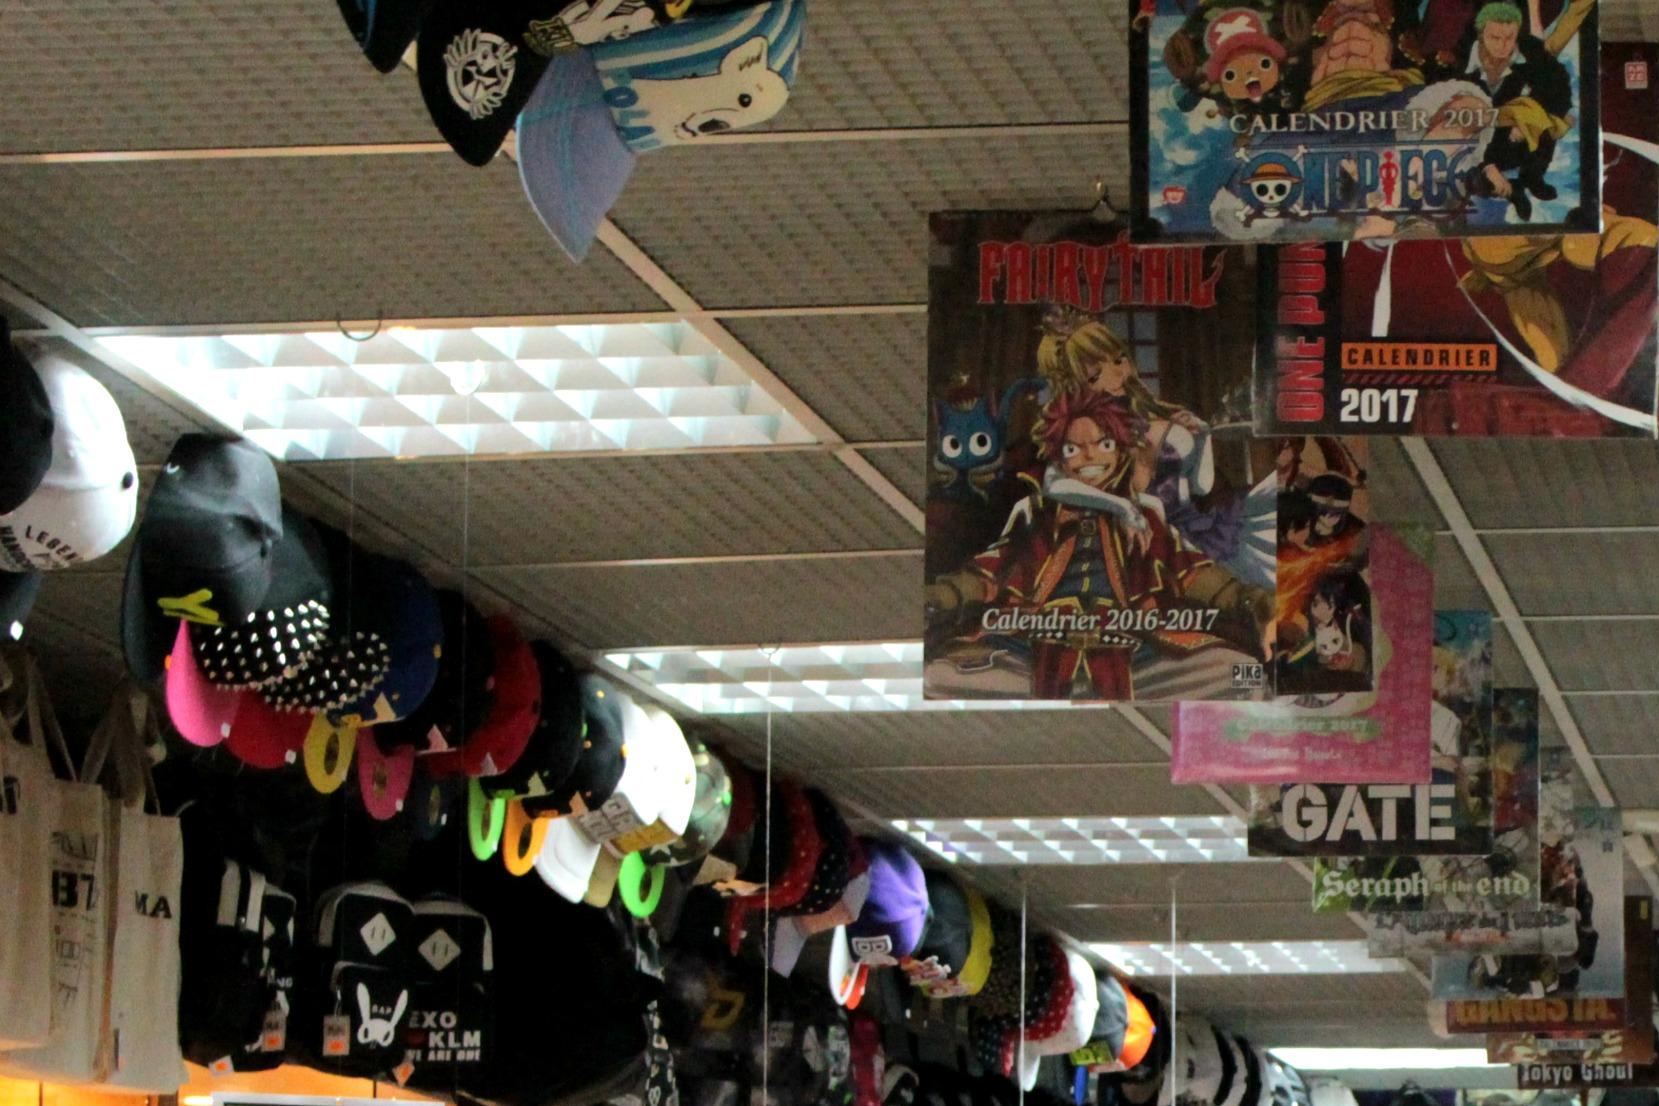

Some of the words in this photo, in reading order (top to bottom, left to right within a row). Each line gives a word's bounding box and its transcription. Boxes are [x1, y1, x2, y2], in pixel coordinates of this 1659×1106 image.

[1229, 109, 1429, 135] CALENDRIER
[1444, 107, 1500, 128] 2017
[978, 240, 1114, 310] FAIRY
[1110, 230, 1227, 308] TAIL
[1346, 346, 1493, 367] CALENDRIER
[1276, 336, 1326, 423] ONE
[1340, 388, 1418, 424] 2017
[981, 608, 1100, 632] Calendrier
[1105, 608, 1219, 633] 2016-2017
[1282, 783, 1456, 842] GATE
[1321, 869, 1430, 901] Seraph
[1476, 870, 1532, 897] end
[408, 1010, 457, 1029] EXO
[428, 1029, 481, 1049] KLM
[1520, 1063, 1573, 1085] Tokyo
